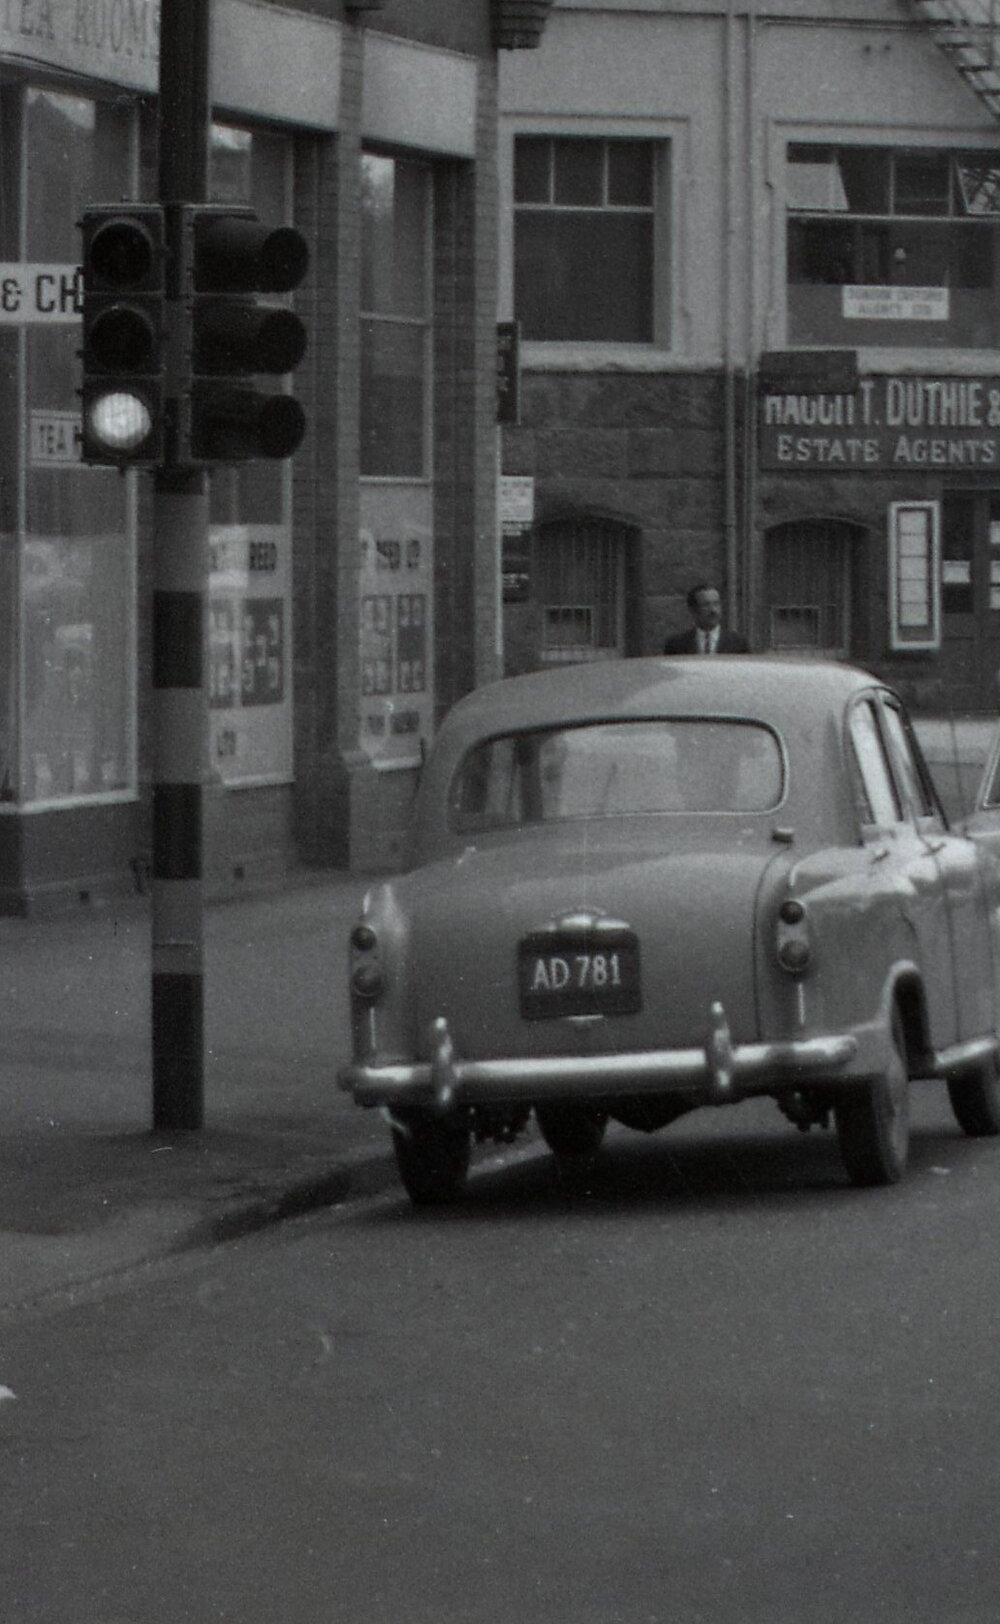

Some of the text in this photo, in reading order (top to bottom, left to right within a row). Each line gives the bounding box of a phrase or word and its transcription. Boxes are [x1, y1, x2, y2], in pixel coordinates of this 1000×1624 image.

[886, 378, 984, 427] DUTHIE
[775, 432, 880, 464] ESTATE
[892, 433, 997, 465] AGENTS
[531, 952, 622, 991] AD 781
